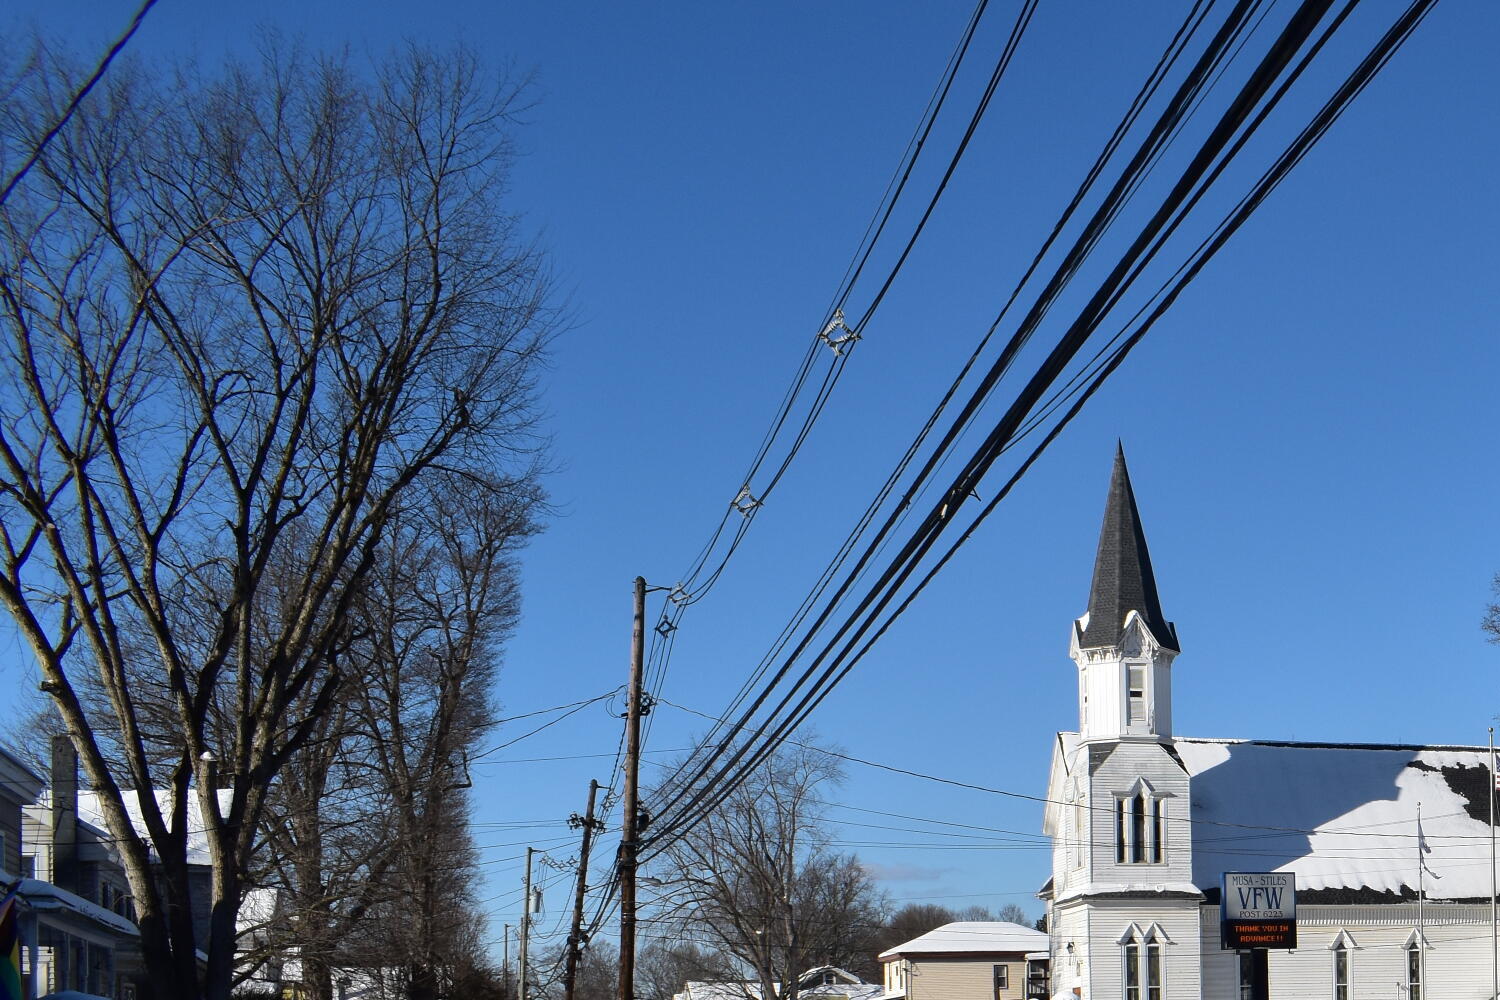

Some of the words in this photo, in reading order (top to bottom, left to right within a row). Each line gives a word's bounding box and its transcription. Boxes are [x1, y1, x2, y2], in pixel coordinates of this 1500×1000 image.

[1232, 875, 1254, 886] MUSA
[1260, 875, 1287, 886] STILES
[1238, 887, 1284, 910] VFW
